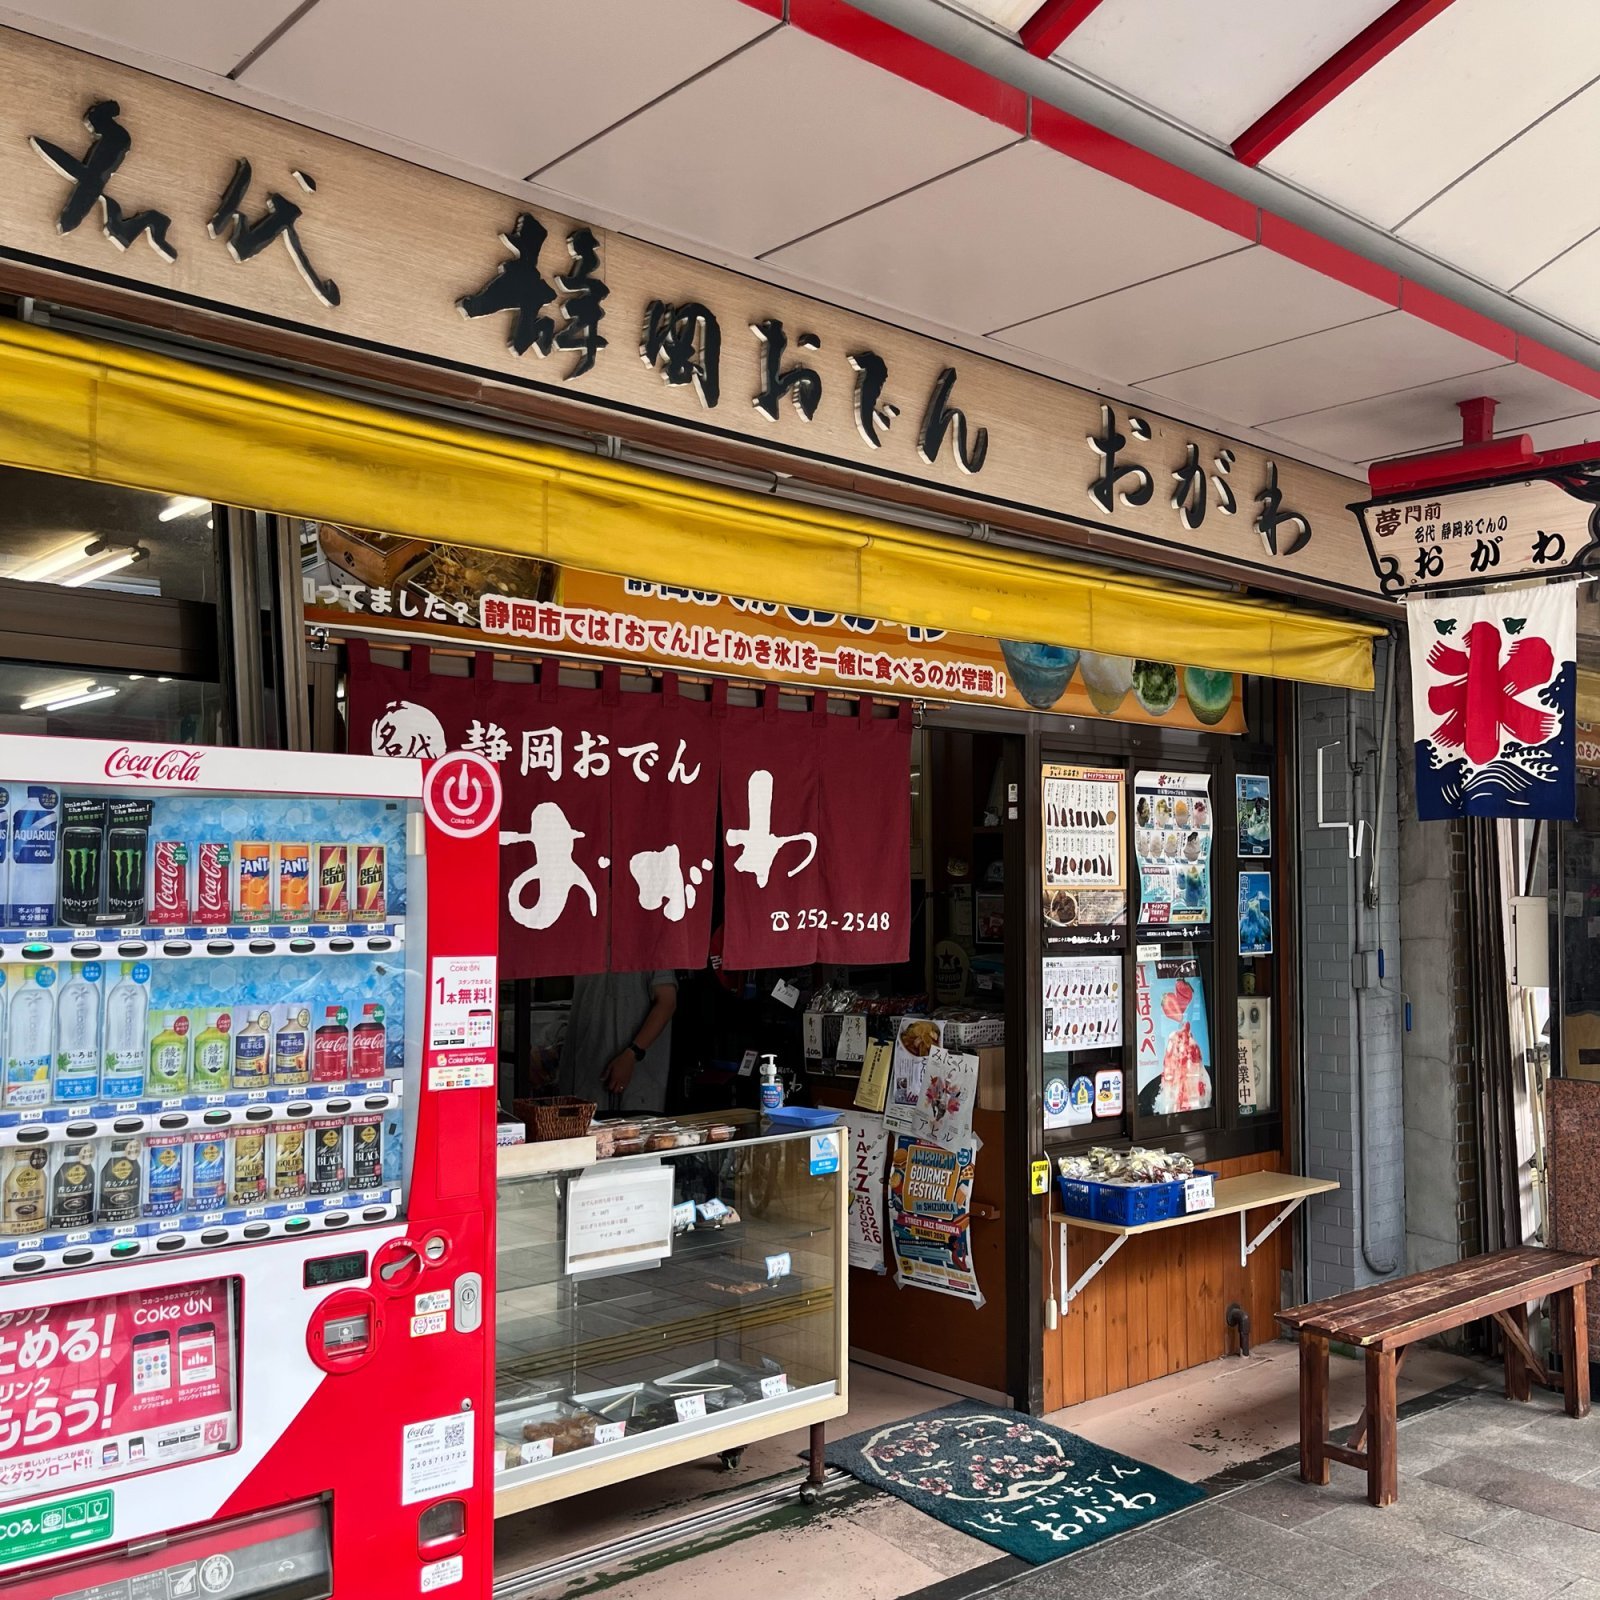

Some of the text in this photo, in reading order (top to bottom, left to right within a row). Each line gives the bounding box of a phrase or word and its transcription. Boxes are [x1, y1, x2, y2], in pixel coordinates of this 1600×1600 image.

[456, 213, 988, 475] 静岡おでん
[1087, 405, 1312, 556] おがわ
[1375, 503, 1441, 537] 夢門前
[1414, 516, 1508, 543] 名代 静岡おでんの
[1414, 530, 1566, 579] おがわ
[484, 599, 1003, 694] 静岡市では「おでん」と「かき氷」を一緒に食べるのが常識!
[1426, 621, 1555, 765] 氷
[461, 719, 701, 784] 静岡おでん
[14, 830, 55, 841] AQUARIUS
[499, 769, 817, 930] おがわ
[797, 909, 890, 932] 252-2548
[1238, 1046, 1251, 1104] 営業中
[855, 1128, 869, 1193] JAZZ
[910, 1165, 953, 1187] GOURMET
[912, 1149, 956, 1170] AMERICAN
[908, 1182, 948, 1202] FESTIVAL
[923, 1202, 955, 1213] SHIZUOKA
[864, 1196, 882, 1245] 2026
[904, 1216, 922, 1226] STREET
[923, 1219, 935, 1229] JAZZ
[133, 1297, 213, 1326] Coke ON
[407, 1423, 436, 1440] Coca-Cola
[1031, 1488, 1157, 1541] おがわ
